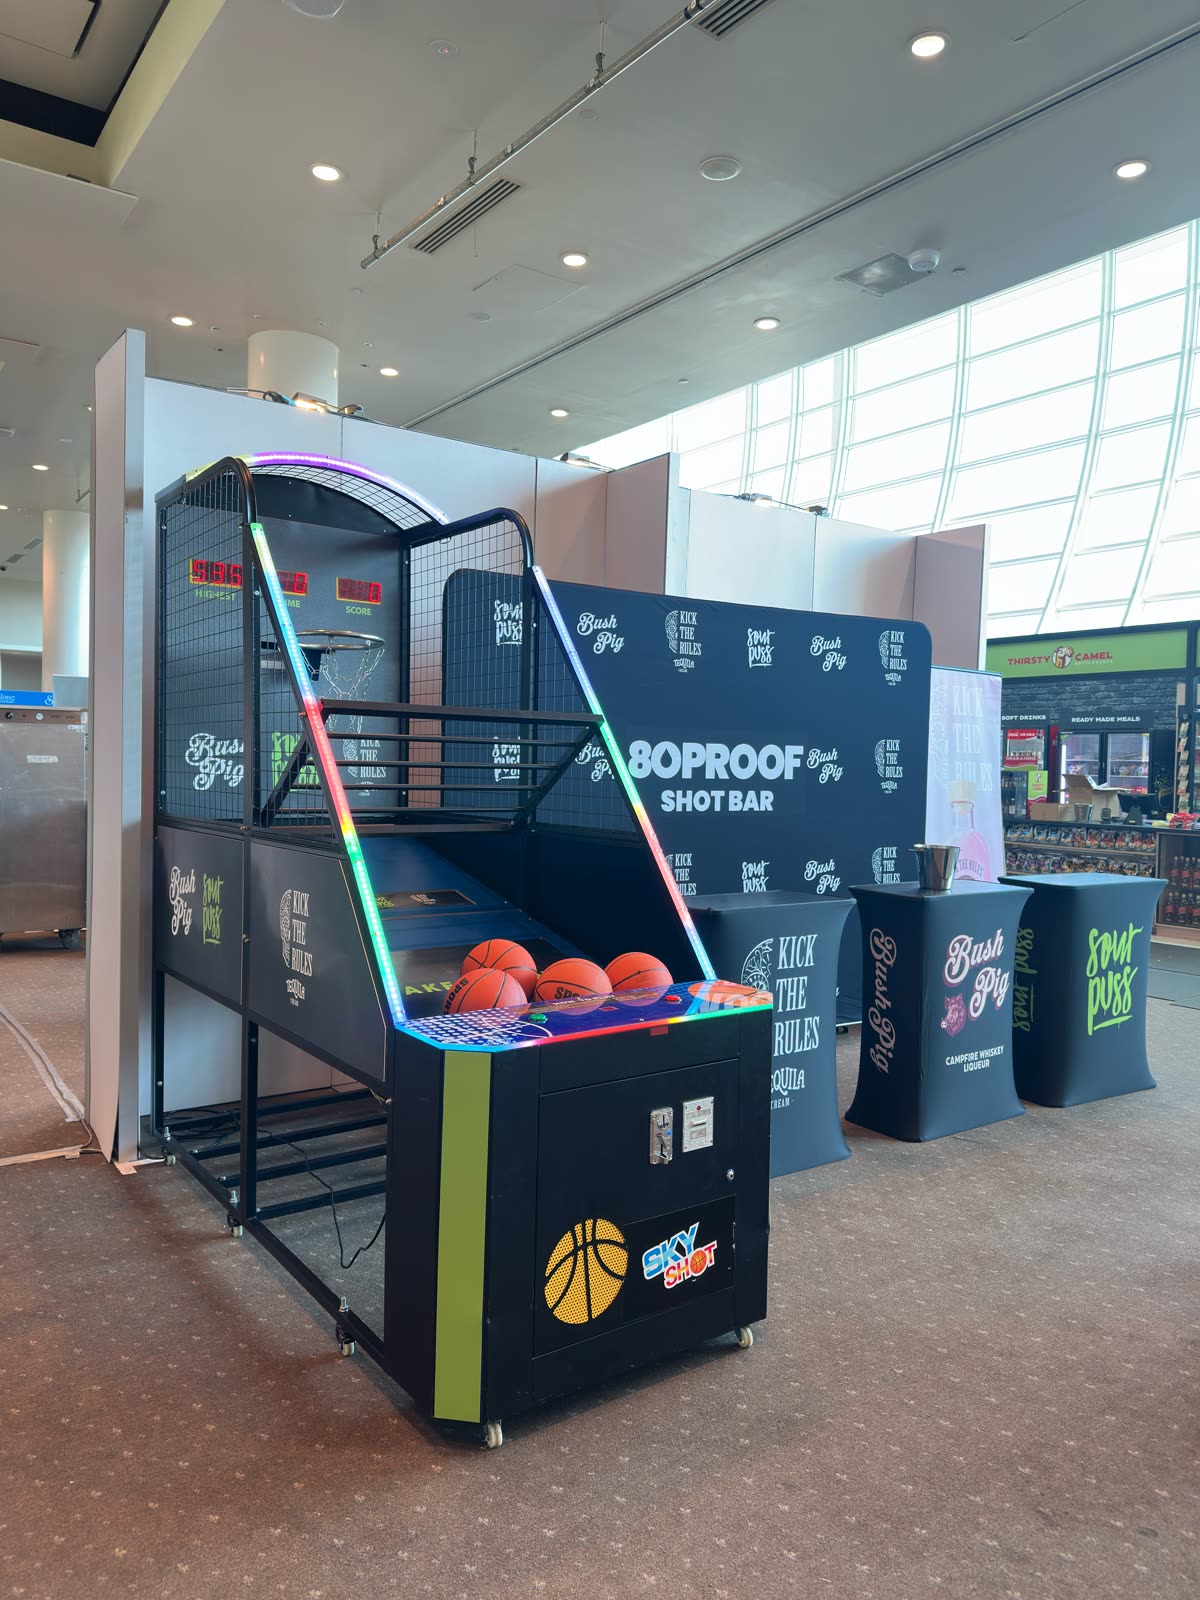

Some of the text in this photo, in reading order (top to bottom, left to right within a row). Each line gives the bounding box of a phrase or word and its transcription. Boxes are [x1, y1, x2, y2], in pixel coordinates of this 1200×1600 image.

[293, 572, 307, 594] 0
[369, 582, 382, 603] 0
[195, 589, 236, 600] HIGHEST
[345, 605, 372, 616] SCORE
[680, 610, 698, 625] KICK
[576, 612, 618, 636] Bush
[679, 626, 695, 640] THE
[593, 631, 625, 654] Pig
[810, 635, 842, 656] Bush
[890, 630, 905, 643] KICK
[679, 641, 702, 656] RULES
[890, 644, 903, 656] THE
[1007, 651, 1113, 665] THIRSTY CAMEL
[673, 658, 695, 669] TEQUILA
[822, 651, 848, 672] Pig
[889, 658, 908, 671] RULES
[952, 685, 984, 717] KICK
[886, 739, 901, 751] KICK
[952, 723, 983, 754] THE
[184, 732, 244, 767] Bus
[360, 749, 378, 761] THE
[628, 740, 804, 780] 80PROOF
[806, 748, 839, 769] Bush
[886, 753, 898, 765] THE
[819, 763, 844, 784] Pig
[885, 766, 904, 778] RULES
[660, 789, 774, 812] SHOT BAR
[675, 853, 692, 866] KICK
[883, 846, 898, 859] KICK
[674, 868, 690, 881] THE
[804, 859, 836, 881] Bush
[883, 860, 896, 872] THE
[169, 865, 197, 904] Bush
[816, 874, 841, 895] Pig
[882, 873, 901, 884] RULES
[292, 890, 310, 917] KICK
[171, 897, 193, 936] Pig
[292, 918, 307, 946] THE
[291, 947, 313, 977] RULES
[777, 934, 818, 970] KICK
[943, 928, 1005, 987] Bush
[286, 978, 306, 1000] TEQUILA
[775, 976, 808, 1013] THE
[967, 966, 1011, 1022] Pig
[868, 928, 897, 1074] Bush Pig
[773, 1016, 820, 1057] RULES
[945, 1045, 1004, 1066] CAMPFIRE WHISKEY
[963, 1059, 990, 1072] LIQUEUR
[771, 1067, 805, 1096] QUILA
[643, 1222, 699, 1280] SKY
[664, 1241, 717, 1288] SHOT
